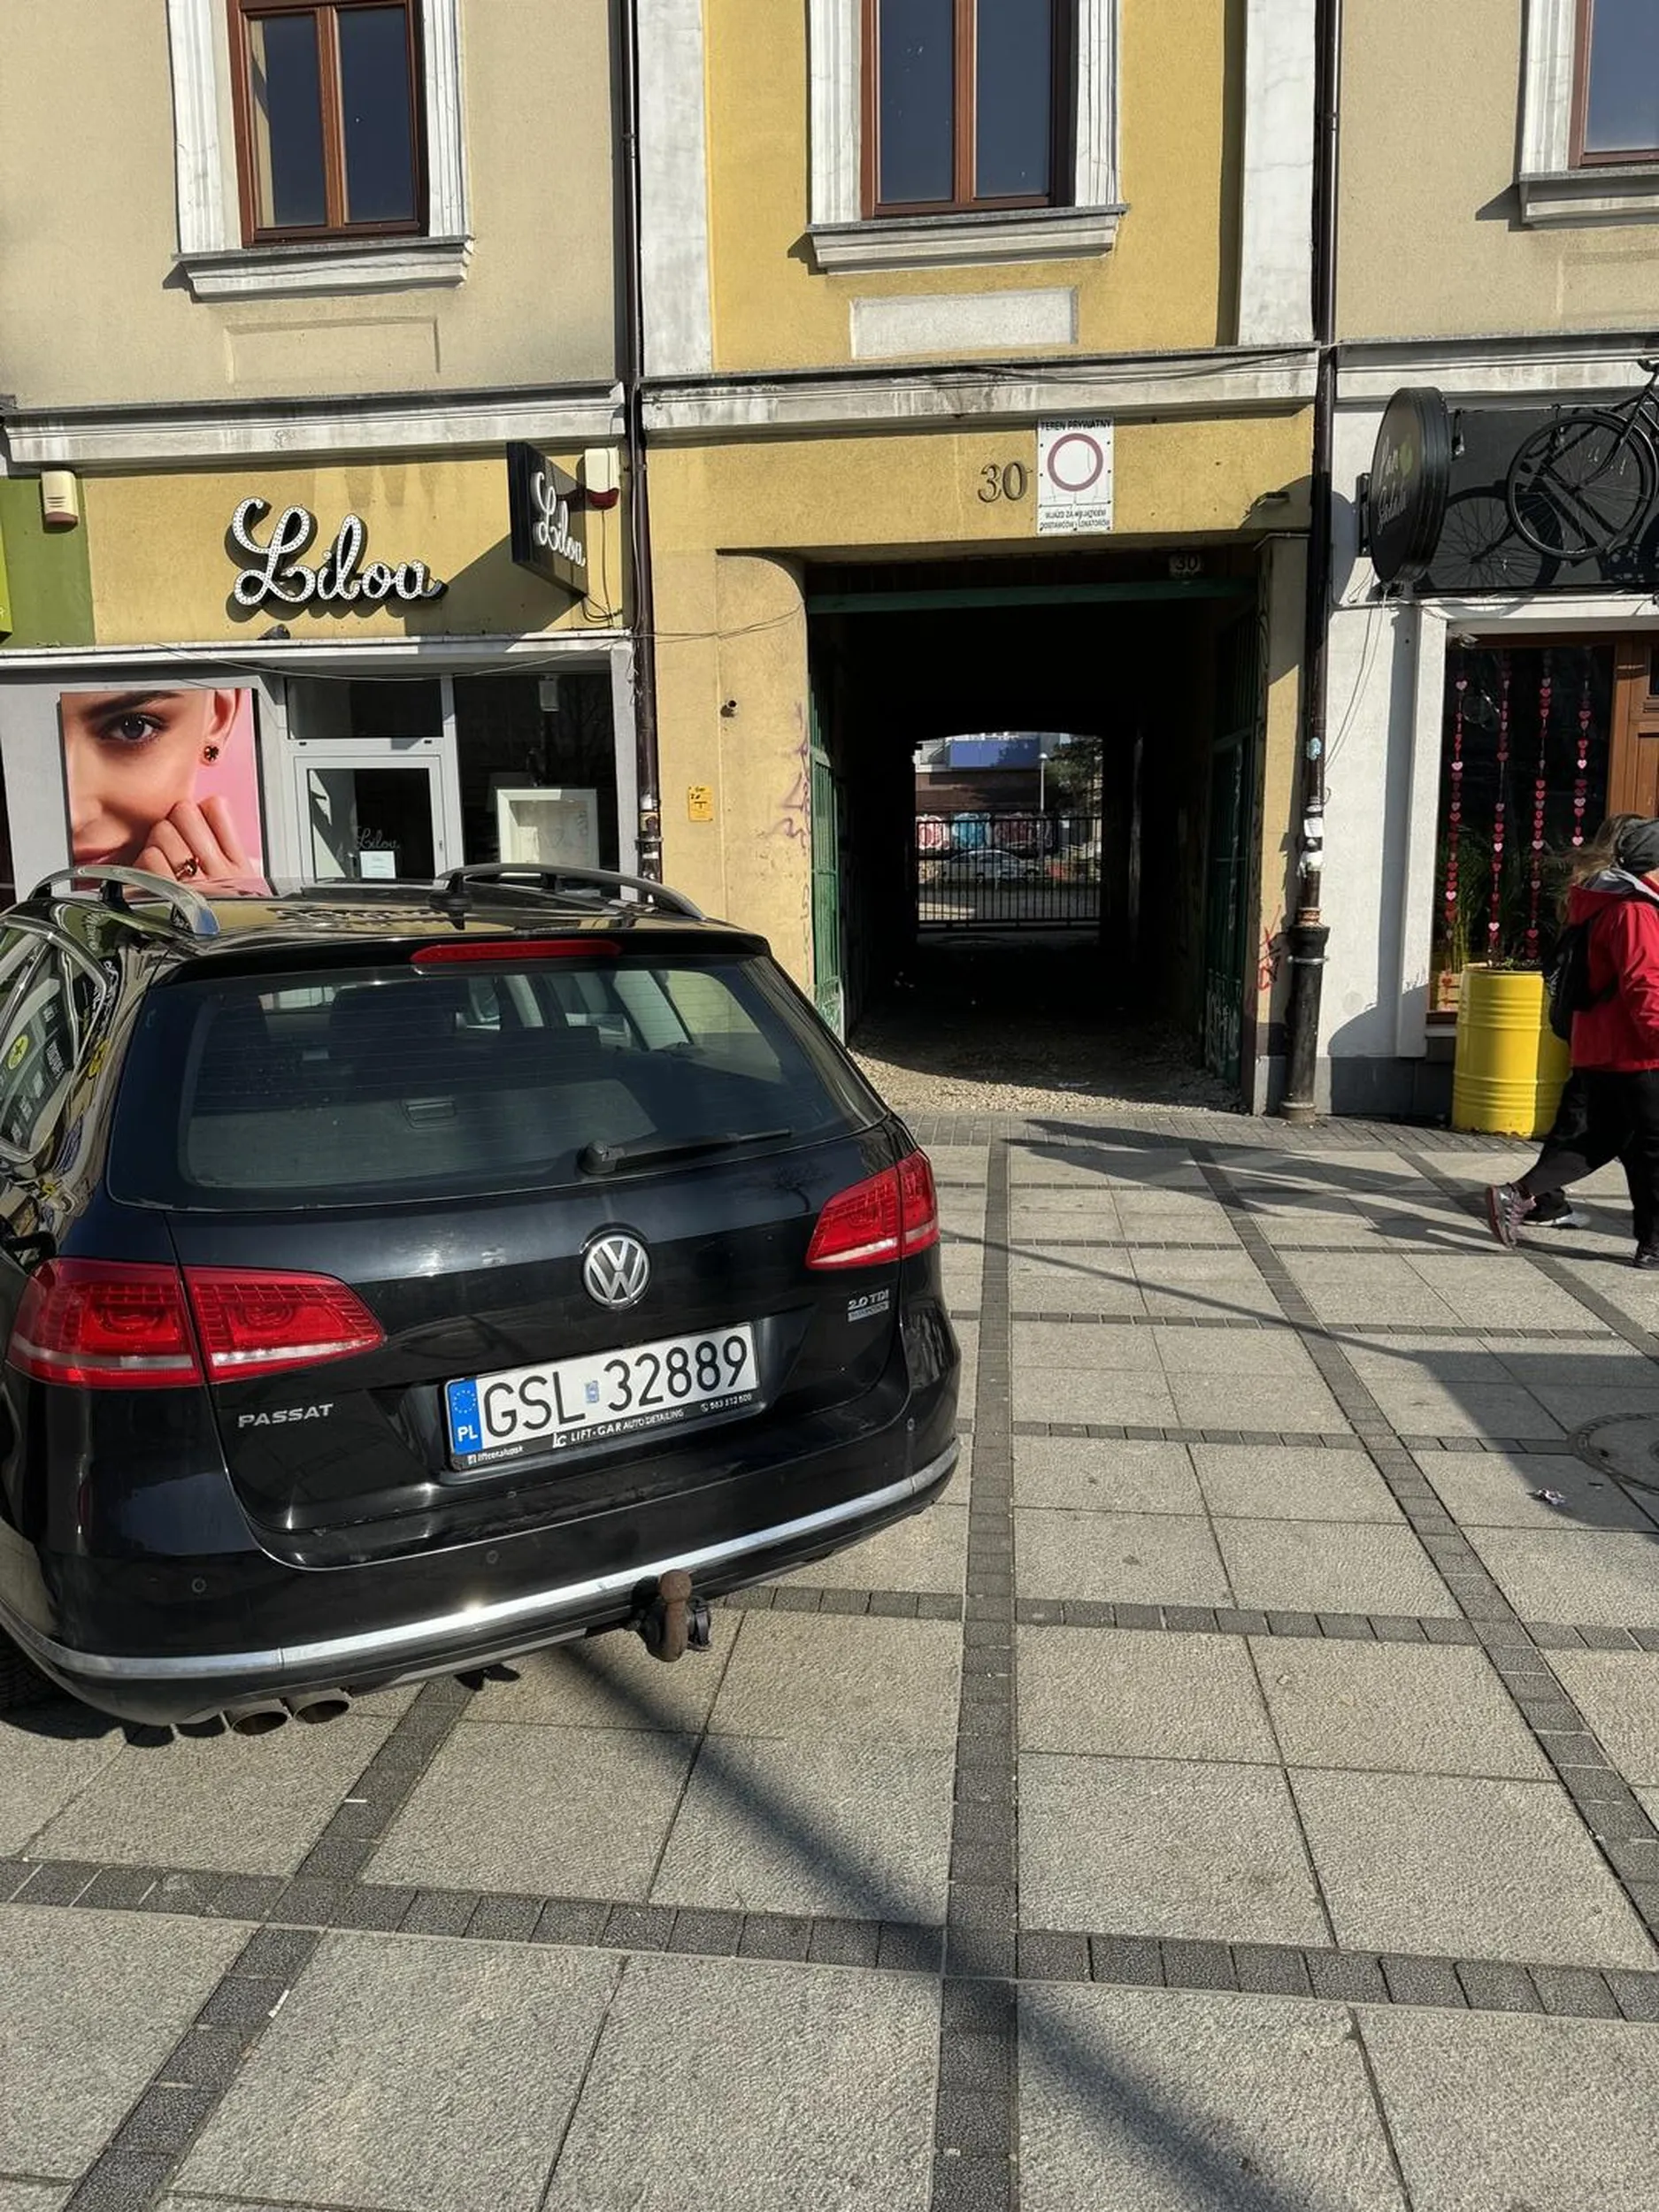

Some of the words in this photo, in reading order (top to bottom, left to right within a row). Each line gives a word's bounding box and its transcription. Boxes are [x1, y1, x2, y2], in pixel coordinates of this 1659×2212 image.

[977, 461, 1028, 503] 30
[532, 472, 587, 567] Lilou
[232, 495, 449, 606] Lilou
[1175, 554, 1198, 571] 30
[869, 1289, 889, 1303] TDI
[483, 1371, 586, 1438] GSL
[603, 1335, 749, 1412] 32889
[238, 1402, 334, 1428] PASSAT
[623, 1418, 645, 1430] AUTO
[457, 1426, 478, 1442] PL
